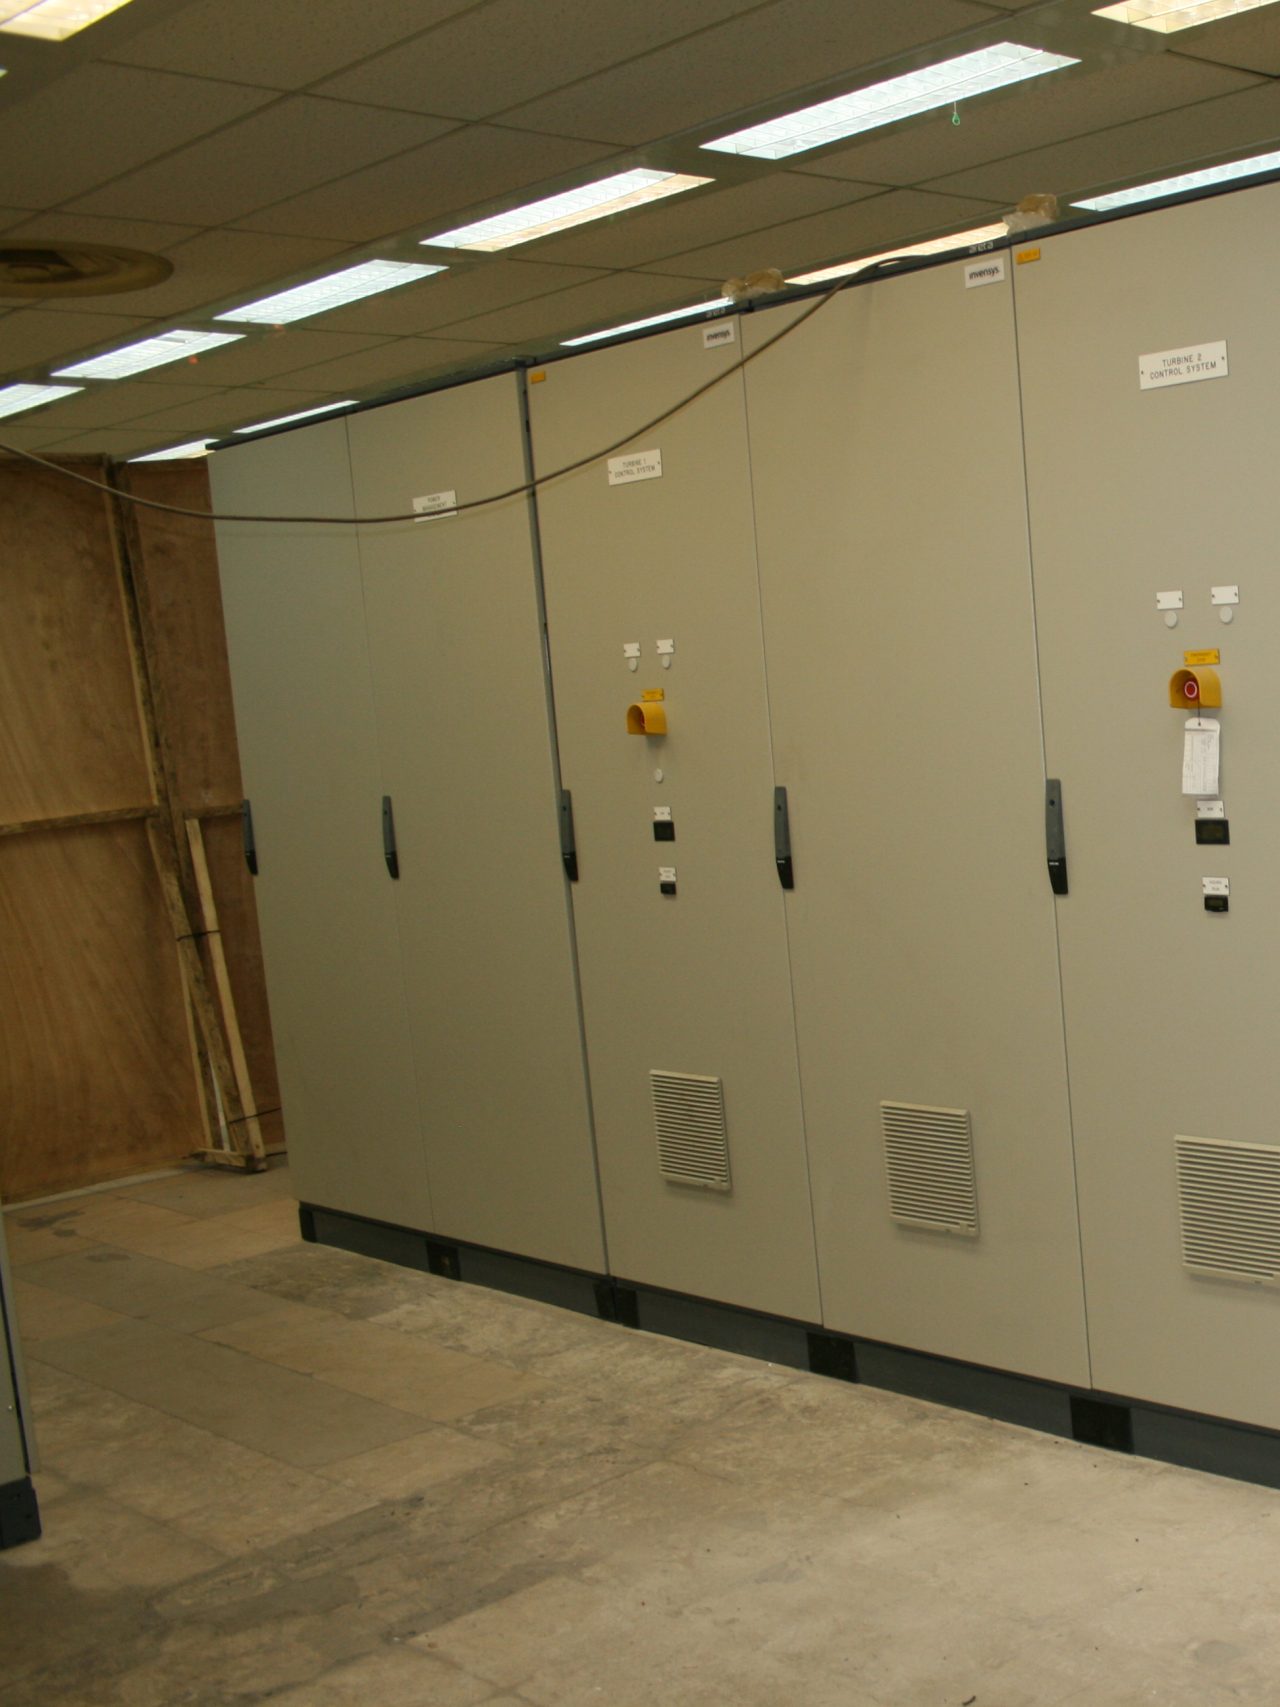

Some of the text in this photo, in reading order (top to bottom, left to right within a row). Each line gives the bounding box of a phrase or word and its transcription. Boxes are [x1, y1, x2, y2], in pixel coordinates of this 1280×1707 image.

[1162, 353, 1203, 368] TURBINE 2
[1150, 361, 1217, 380] CONTROL SYSTEM
